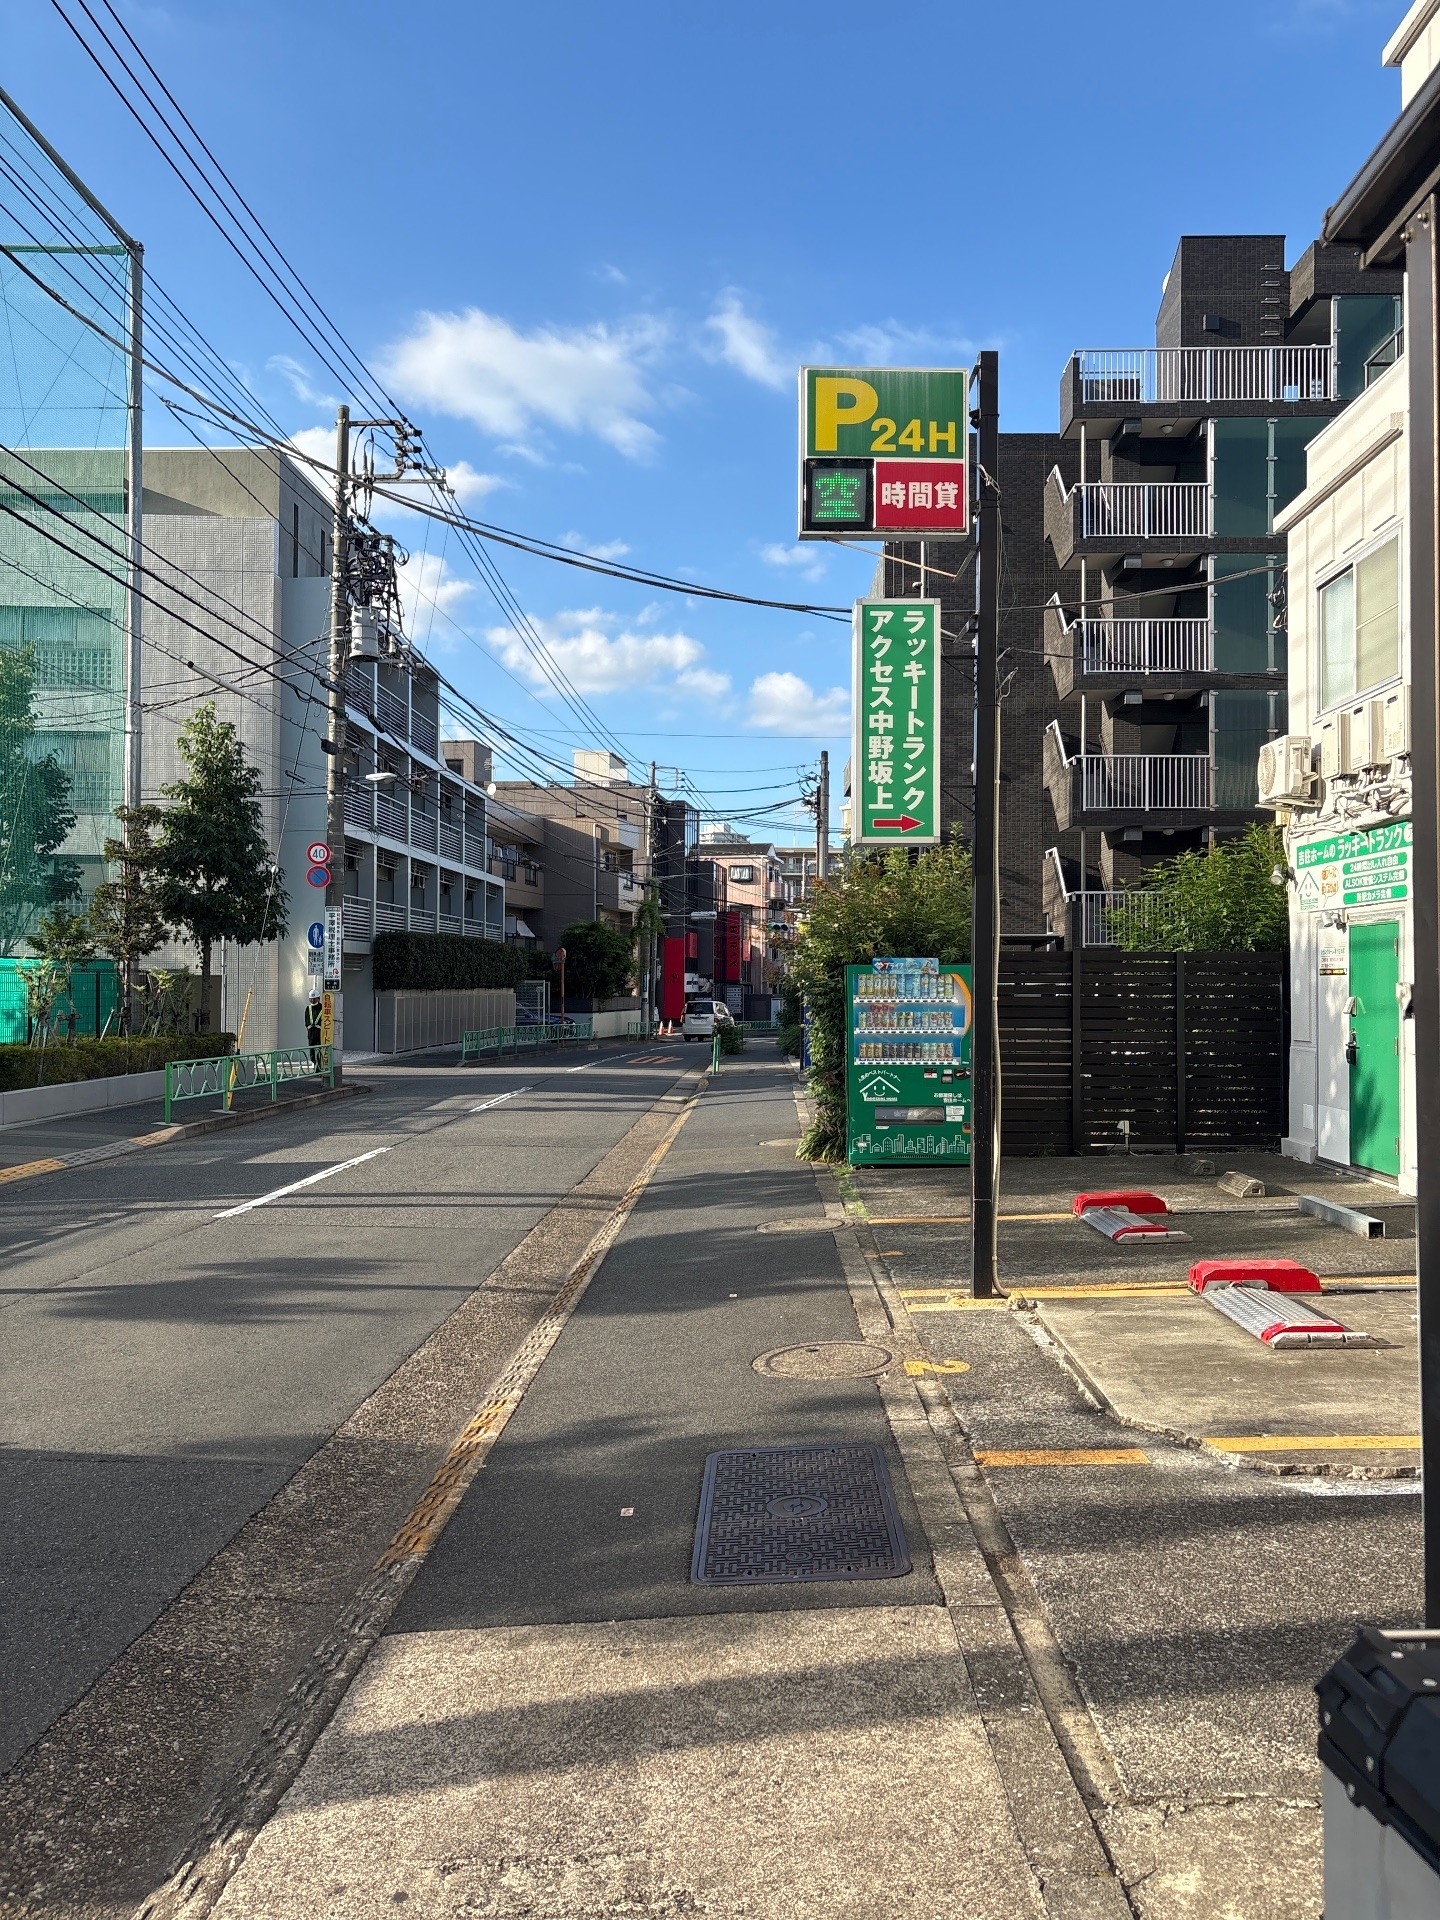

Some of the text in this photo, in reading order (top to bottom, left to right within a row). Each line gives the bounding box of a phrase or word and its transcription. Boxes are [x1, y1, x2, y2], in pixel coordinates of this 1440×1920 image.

[815, 377, 956, 453] P 24H
[815, 472, 860, 518] 空
[881, 481, 959, 510] 時間貸
[868, 610, 895, 810] アクセス中野坂上
[902, 610, 927, 811] ラッキートランク
[312, 848, 325, 859] 40
[903, 1358, 972, 1377] 2
